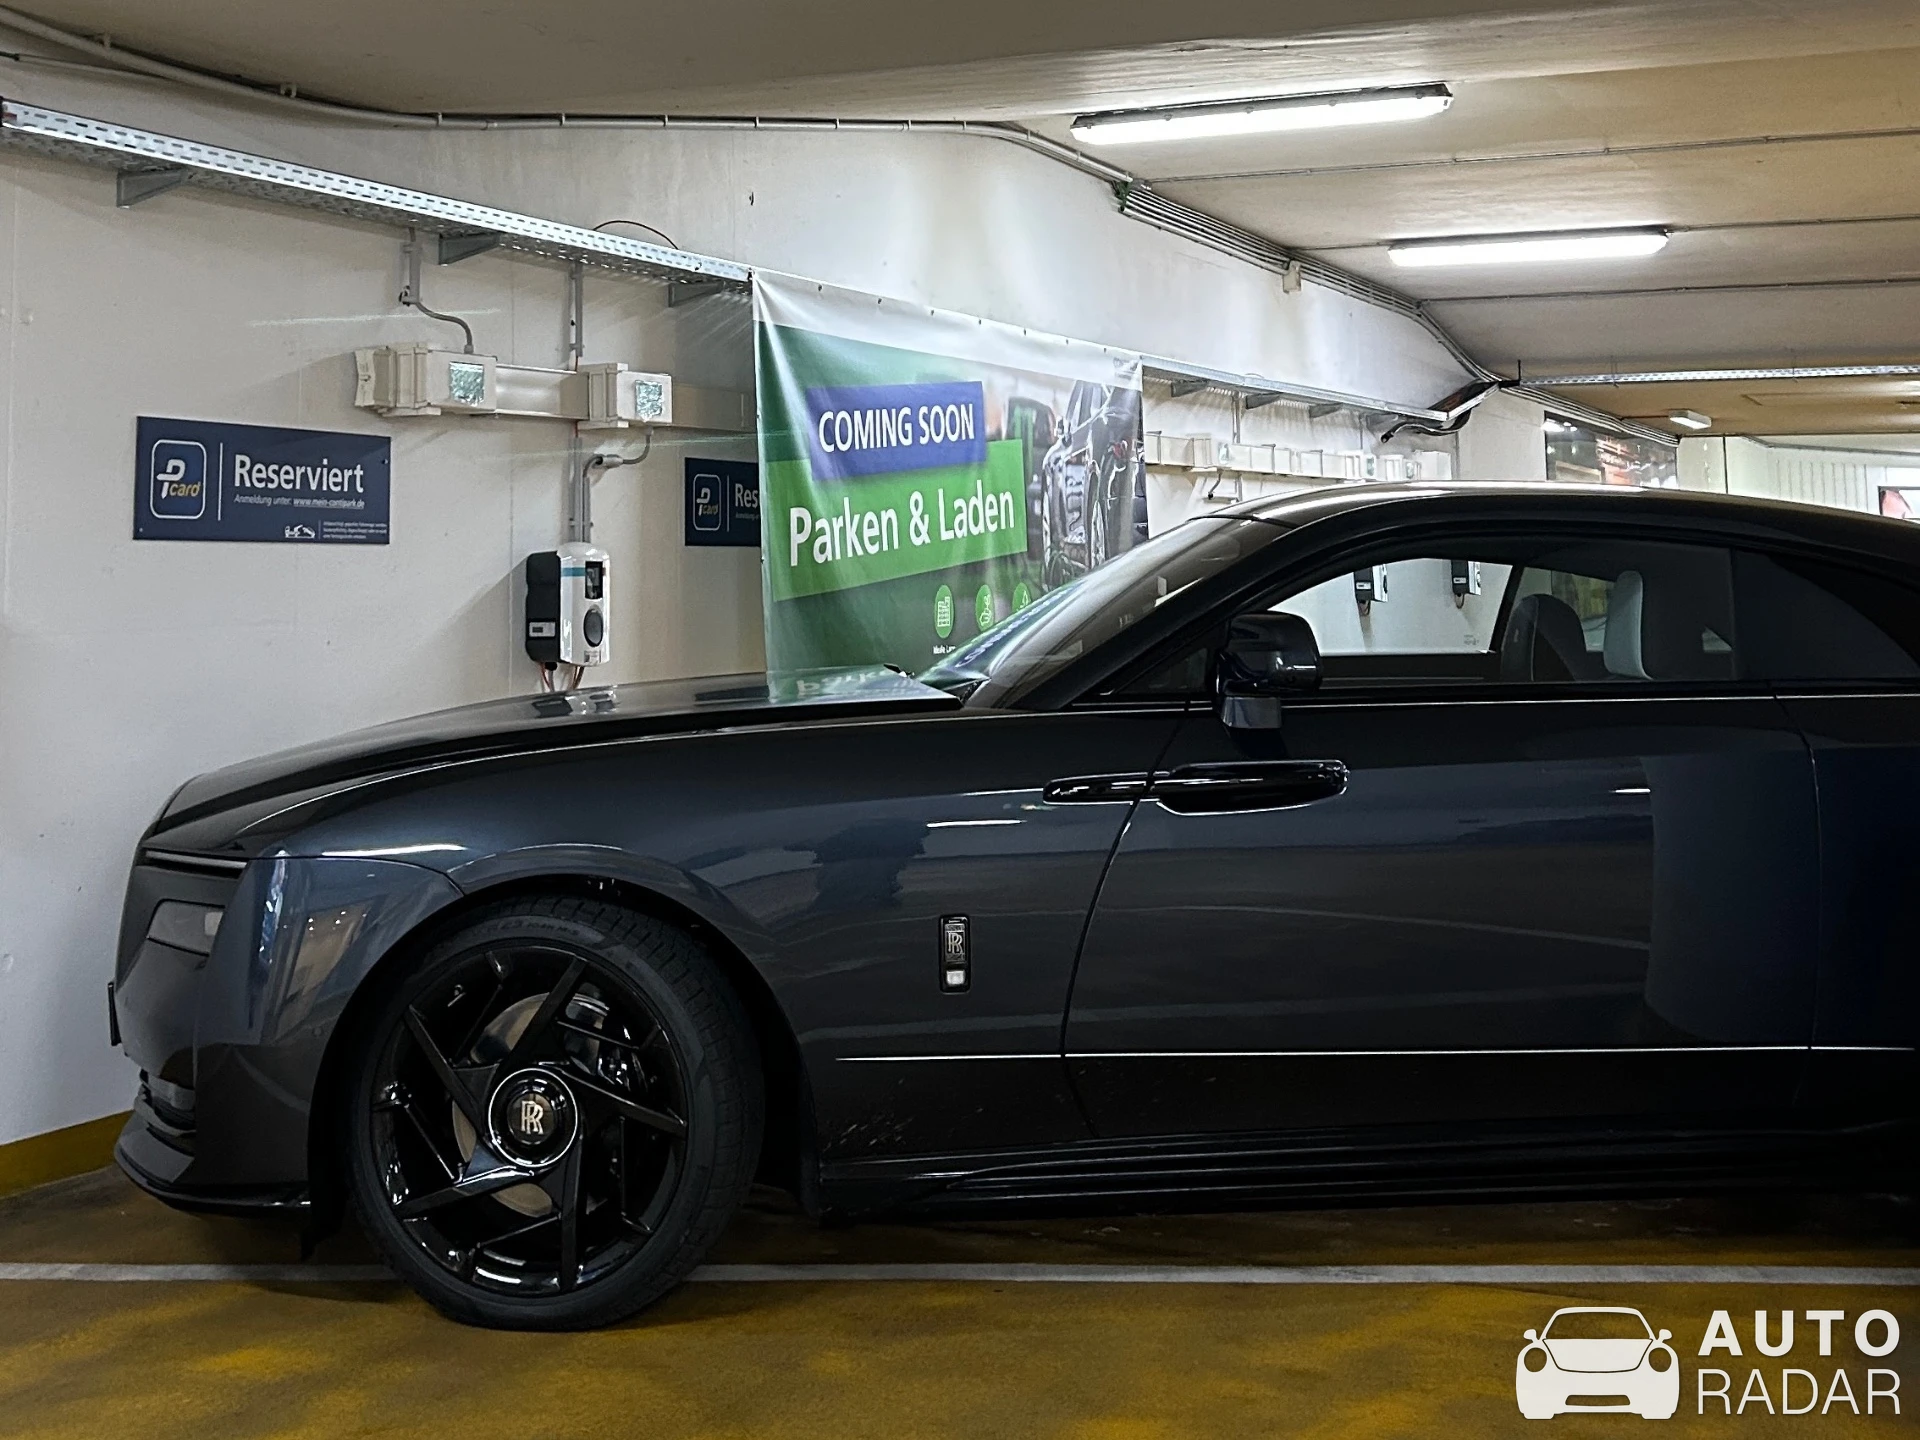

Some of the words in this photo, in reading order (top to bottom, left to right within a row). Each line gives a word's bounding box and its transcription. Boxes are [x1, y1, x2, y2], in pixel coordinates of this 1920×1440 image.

[818, 406, 913, 453] COMING
[918, 403, 975, 445] SOON
[234, 454, 364, 493] Reserviert
[234, 494, 272, 507] Anmeldung
[789, 497, 899, 567] Parken
[909, 491, 931, 546] &
[938, 479, 1015, 542] Laden
[521, 1100, 544, 1135] RR
